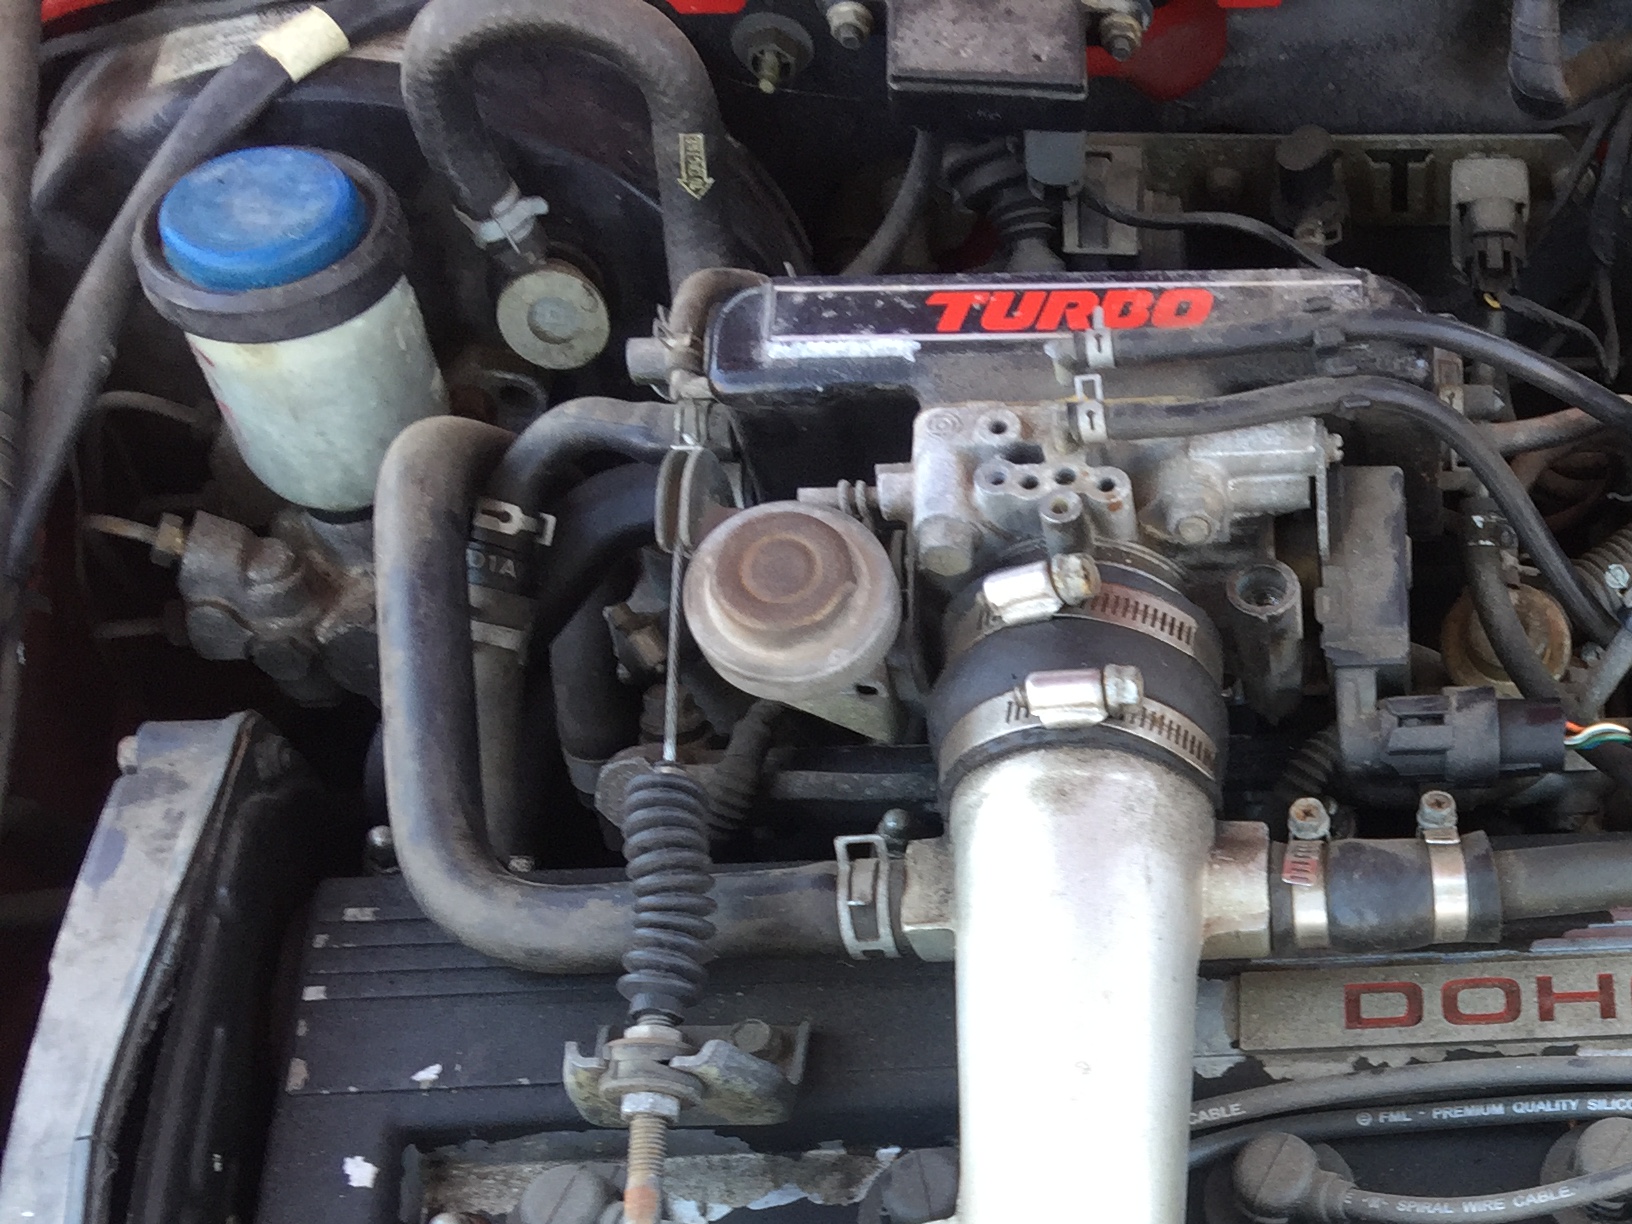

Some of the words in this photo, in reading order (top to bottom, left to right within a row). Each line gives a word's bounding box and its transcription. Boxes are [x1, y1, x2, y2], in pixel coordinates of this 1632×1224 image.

[925, 287, 1214, 332] TURBO
[1432, 1102, 1506, 1119] PREMIUM
[1512, 1098, 1580, 1115] QUALITY
[1395, 1201, 1454, 1214] SPIRAL
[1462, 1200, 1506, 1213] WIRE
